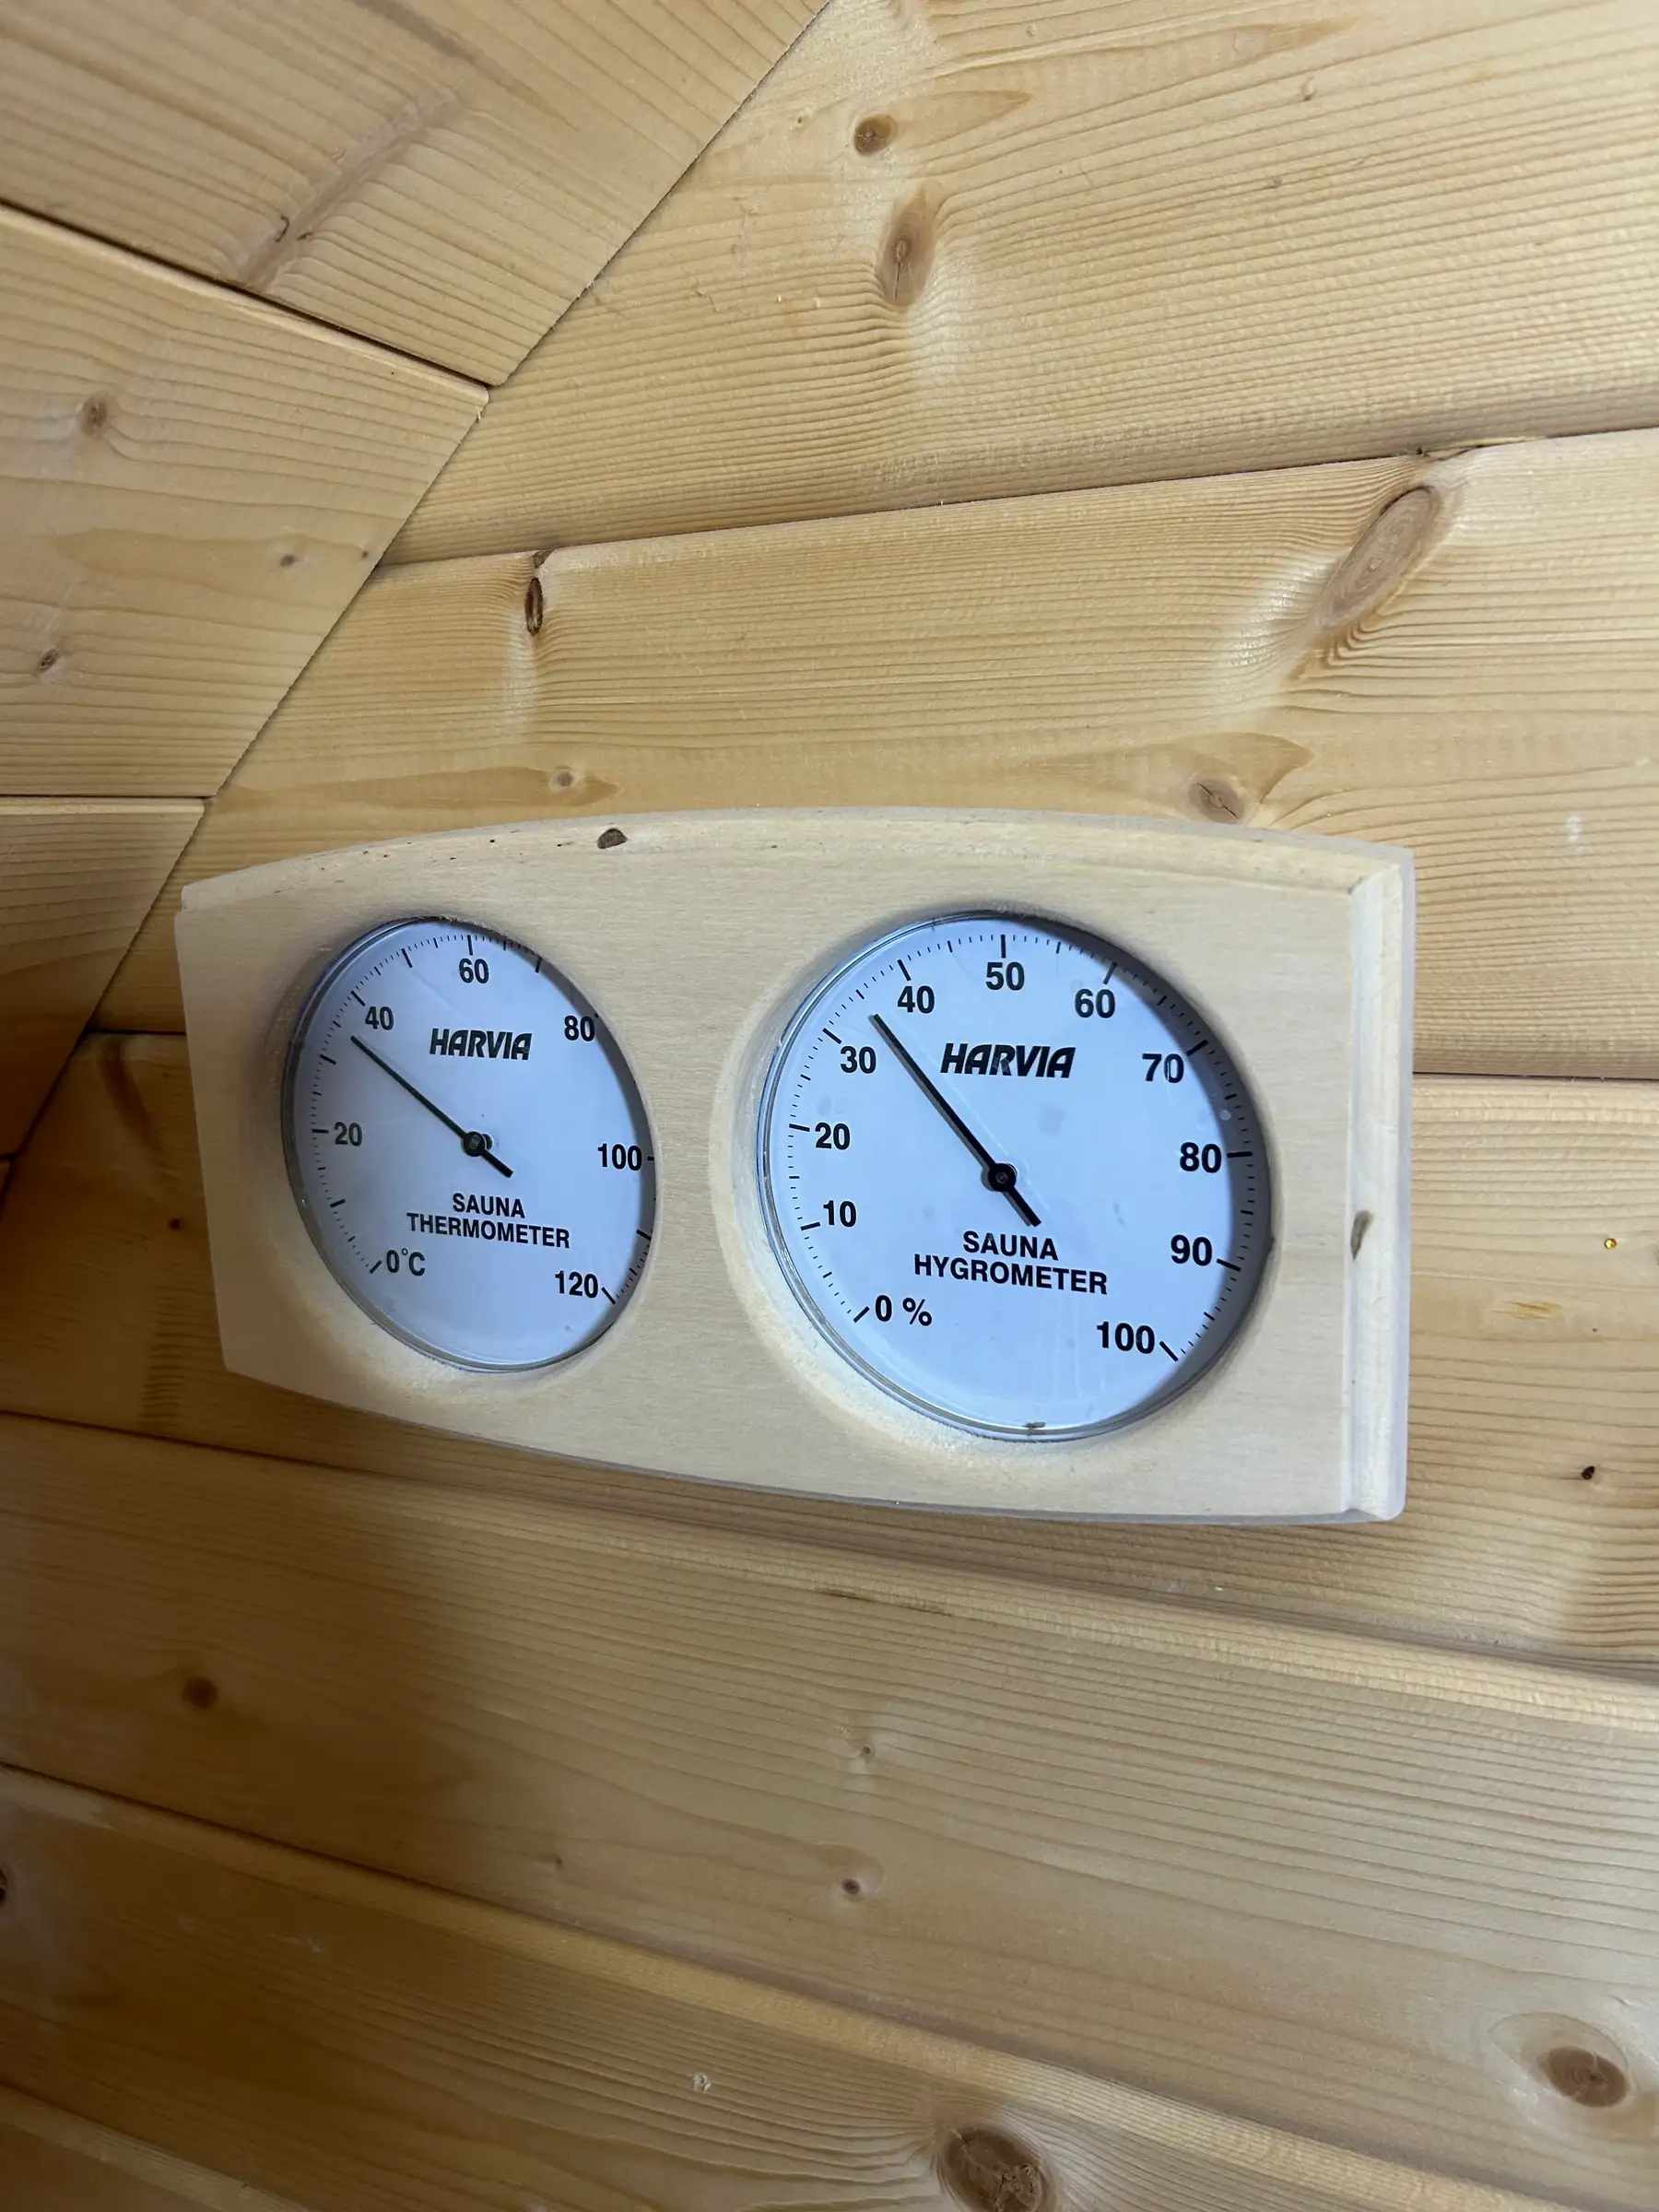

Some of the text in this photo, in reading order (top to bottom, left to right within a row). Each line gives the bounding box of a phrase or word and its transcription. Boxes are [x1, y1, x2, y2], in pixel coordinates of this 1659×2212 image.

[459, 959, 488, 983] 60
[986, 962, 1024, 991] 50
[898, 986, 935, 1014] 40
[1075, 989, 1115, 1018] 60
[365, 1006, 394, 1030] 40
[565, 1016, 595, 1041] 80
[429, 1029, 532, 1060] HARVIA
[841, 1046, 876, 1074] 30
[940, 1043, 1076, 1078] HARVIA
[1142, 1053, 1183, 1083] 70
[335, 1122, 362, 1147] 20
[815, 1123, 850, 1150] 20
[598, 1144, 641, 1171] 100
[1180, 1142, 1221, 1173] 80
[453, 1193, 525, 1218] SAUNA
[823, 1200, 856, 1227] 10
[406, 1213, 570, 1248] THERMOMETER
[963, 1230, 1058, 1260] SAUNA
[1171, 1235, 1212, 1265] 90
[555, 1271, 598, 1298] 120
[914, 1253, 1107, 1295] HYGROMETER
[1097, 1322, 1155, 1354] 100
